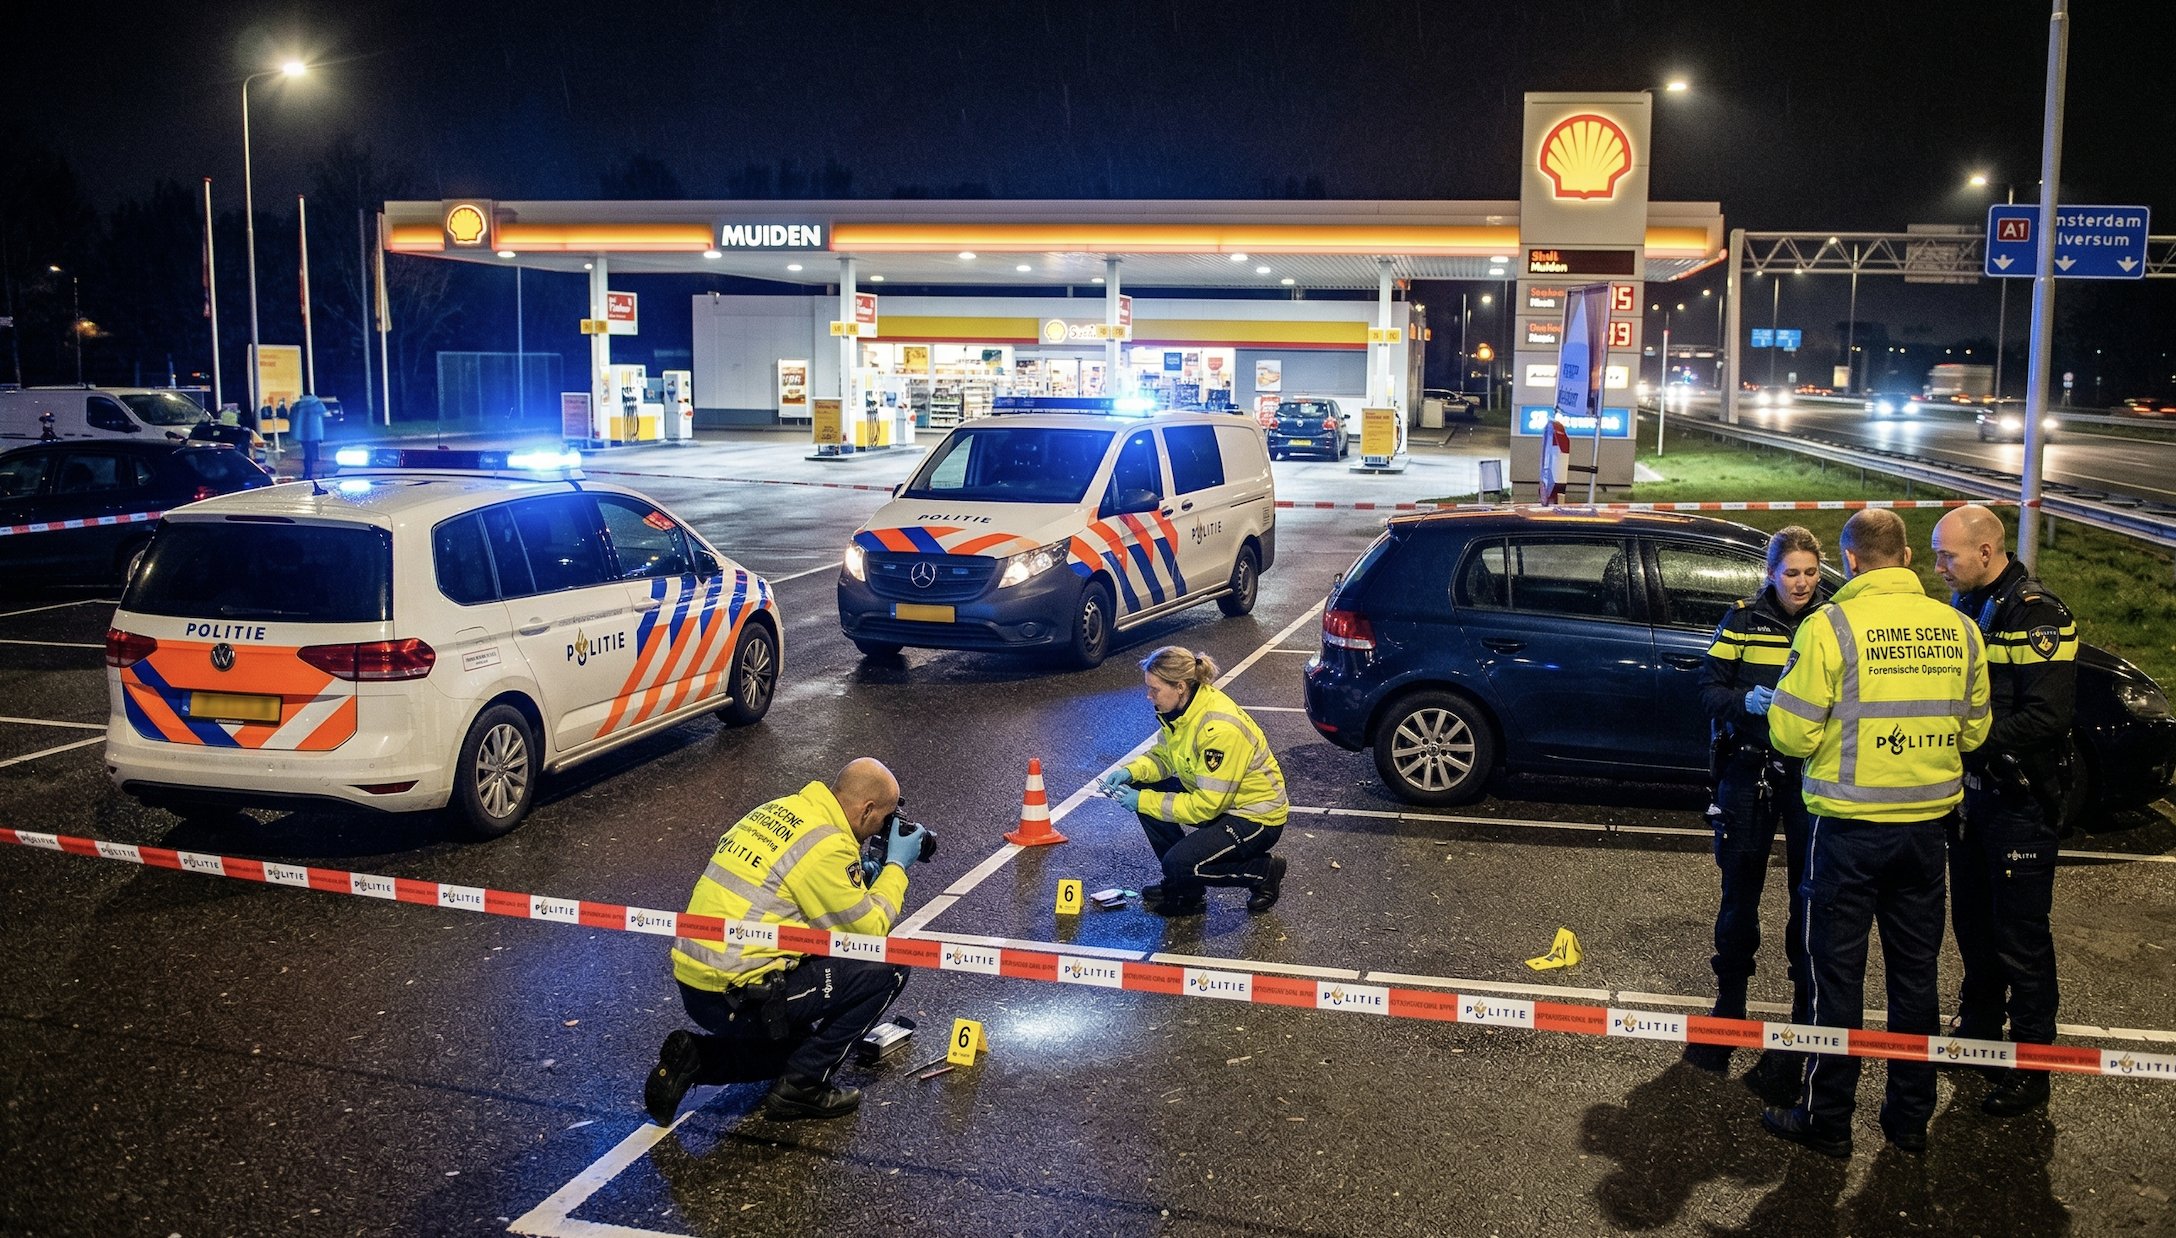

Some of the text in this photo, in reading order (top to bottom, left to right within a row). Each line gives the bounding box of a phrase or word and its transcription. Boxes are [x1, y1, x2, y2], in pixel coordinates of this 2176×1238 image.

[2003, 222, 2025, 238] A1
[2054, 214, 2141, 228] msterdam
[721, 224, 821, 247] MUIDEN
[2055, 233, 2129, 246] lversum
[917, 514, 992, 524] POLITIE
[1191, 515, 1222, 545] POLITIE
[185, 622, 266, 641] POLITIE
[1866, 627, 1960, 643] CRIME SCENE
[567, 627, 625, 666] POLITIE
[1866, 645, 1963, 661] INVESTIGATION
[1868, 664, 1962, 677] Forensische Opsporing
[1876, 723, 1956, 755] POLITIE
[183, 854, 220, 870] POLITIE
[268, 864, 304, 881] POLITIE
[354, 875, 392, 893] POLITIE
[1064, 884, 1074, 902] 6
[442, 887, 481, 904] POLITIE
[535, 898, 575, 917] POLITIE
[631, 909, 673, 928] POLITIE
[729, 921, 773, 940] POLITIE
[835, 932, 881, 954] POLITIE
[946, 946, 994, 966] POLITIE
[1064, 959, 1116, 979] POLITIE
[1190, 971, 1245, 993] POLITIE
[1324, 984, 1381, 1006] POLITIE
[1466, 998, 1526, 1020] POLITIE
[1614, 1011, 1678, 1034] POLITIE
[958, 1026, 971, 1048] 6
[1772, 1025, 1839, 1047] POLITIE
[1937, 1038, 2007, 1060] POLITIE
[2110, 1052, 2176, 1074] POLITI
